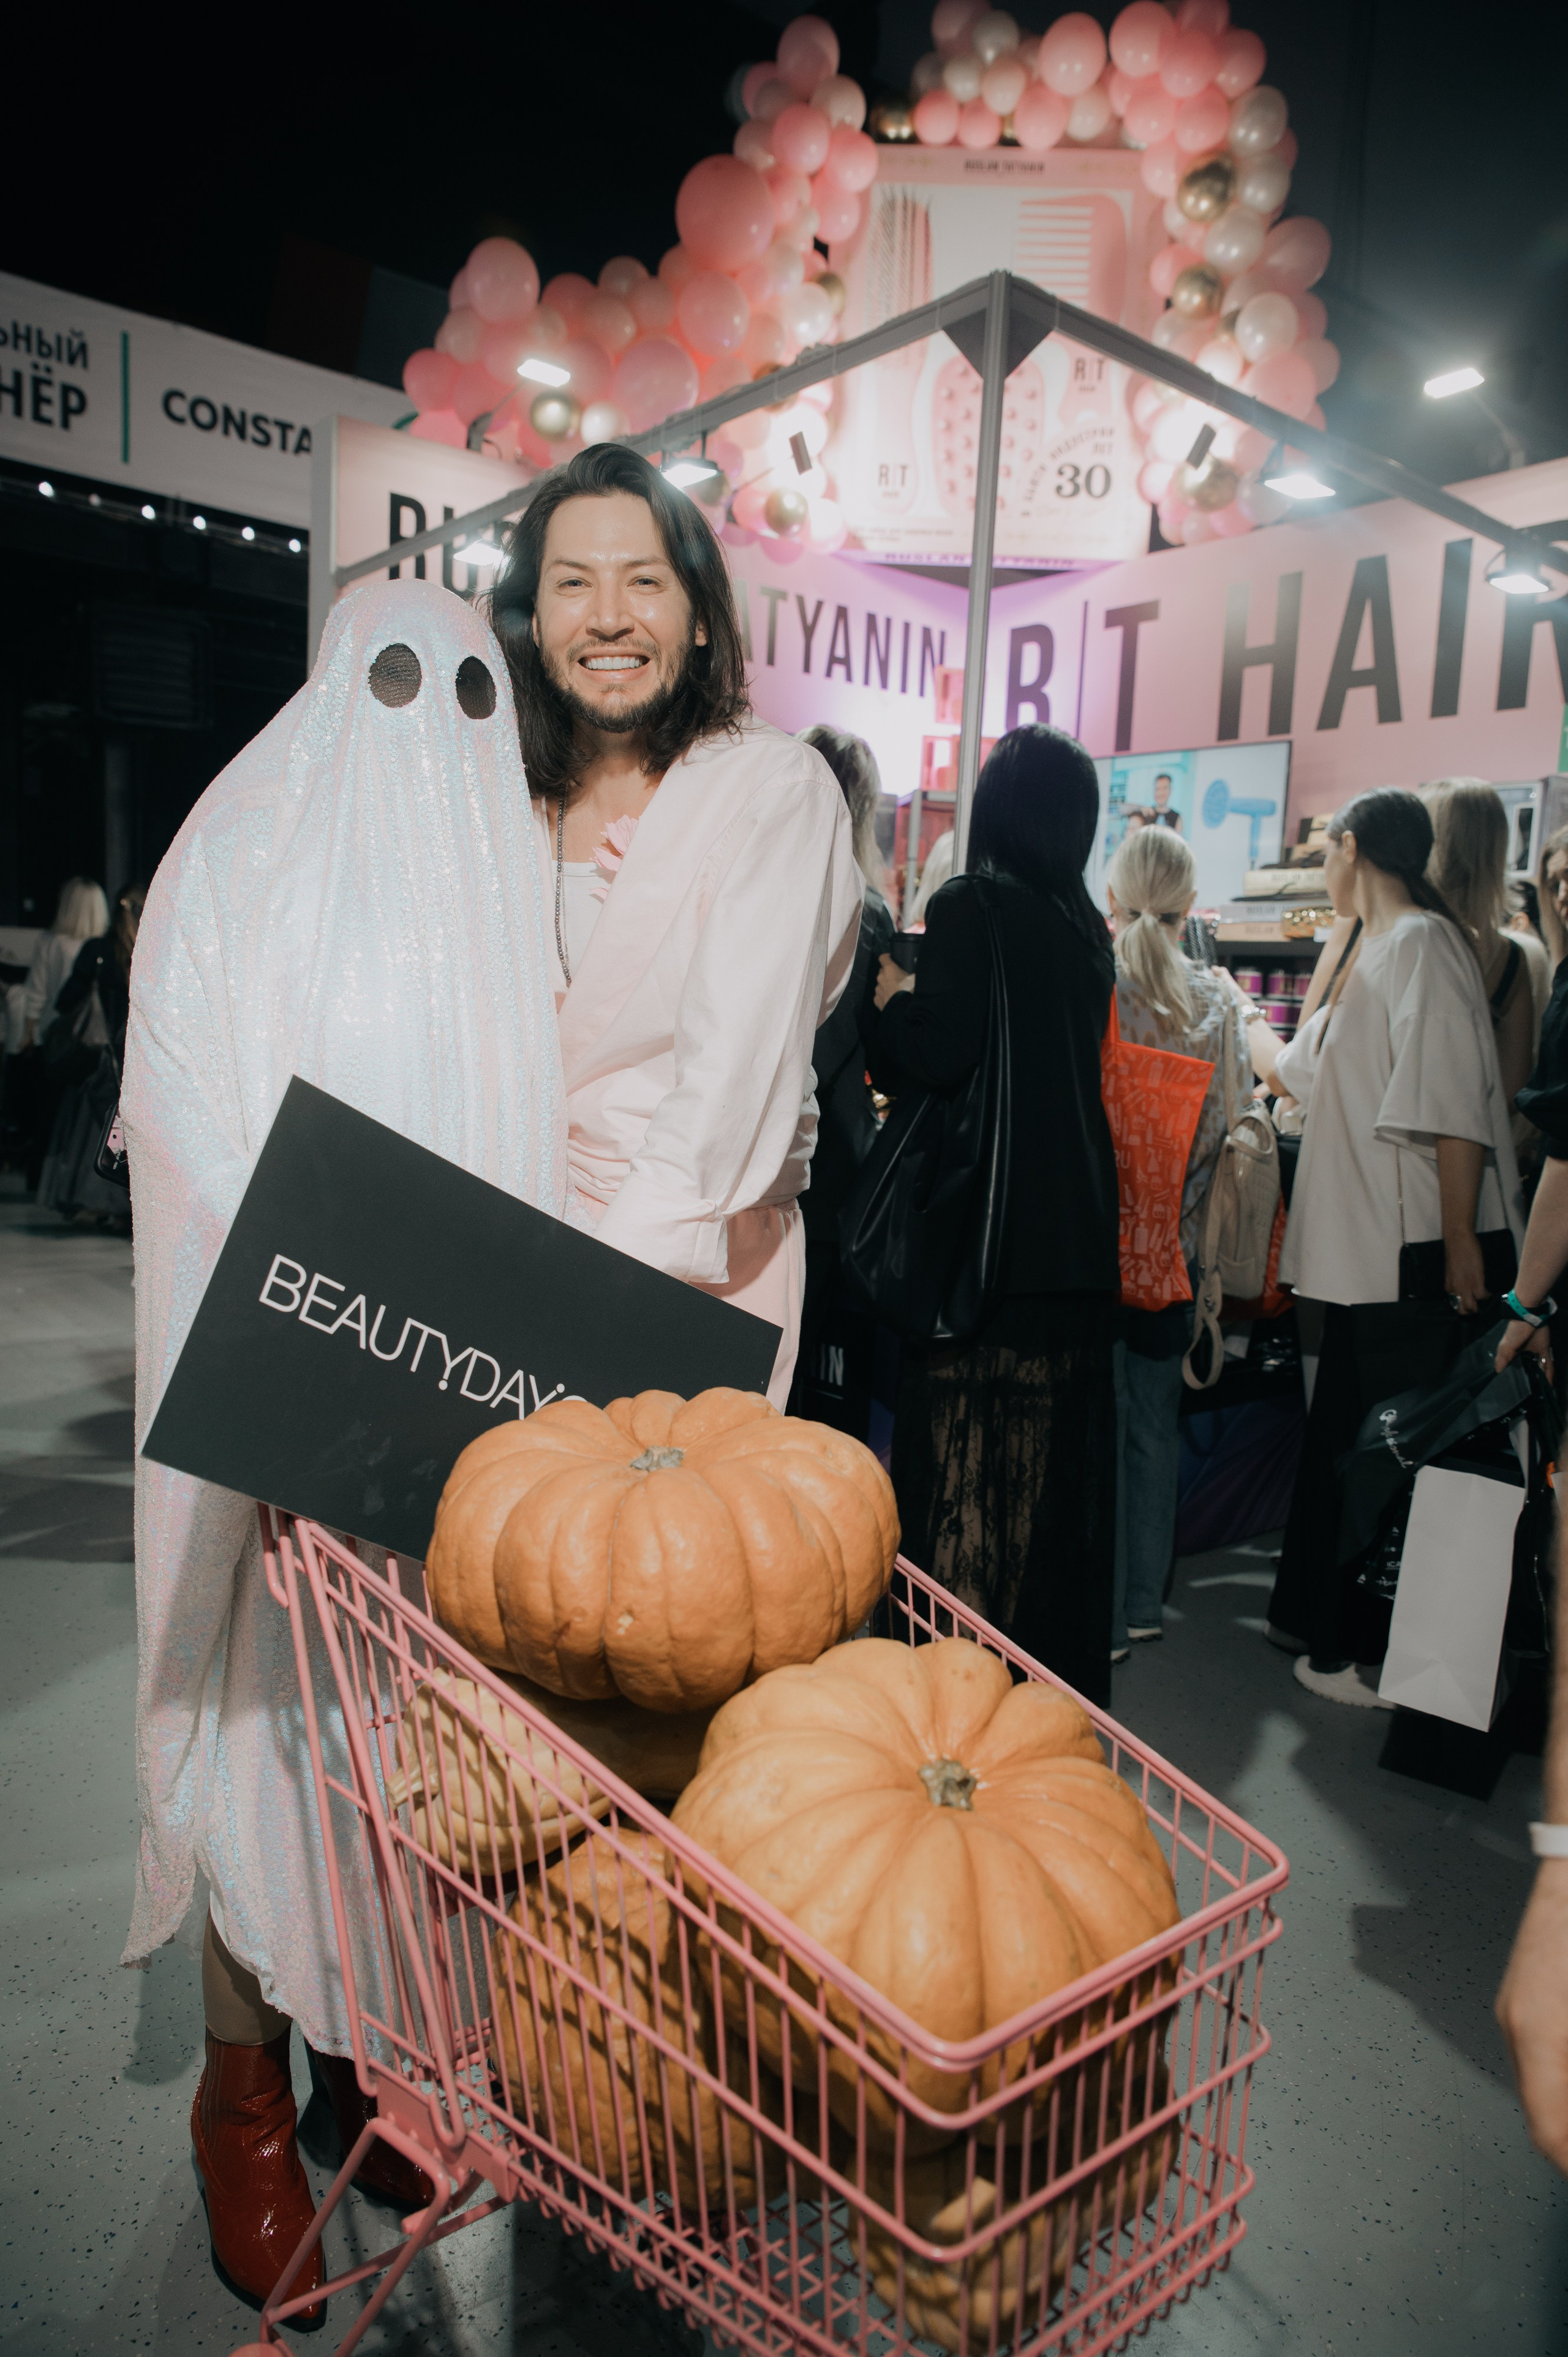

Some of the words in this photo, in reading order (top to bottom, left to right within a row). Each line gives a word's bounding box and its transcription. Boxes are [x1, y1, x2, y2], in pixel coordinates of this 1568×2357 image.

[1055, 463, 1112, 499] 30
[1217, 519, 1568, 741] HAIR
[260, 1254, 587, 1420] BEAUTYDAY
